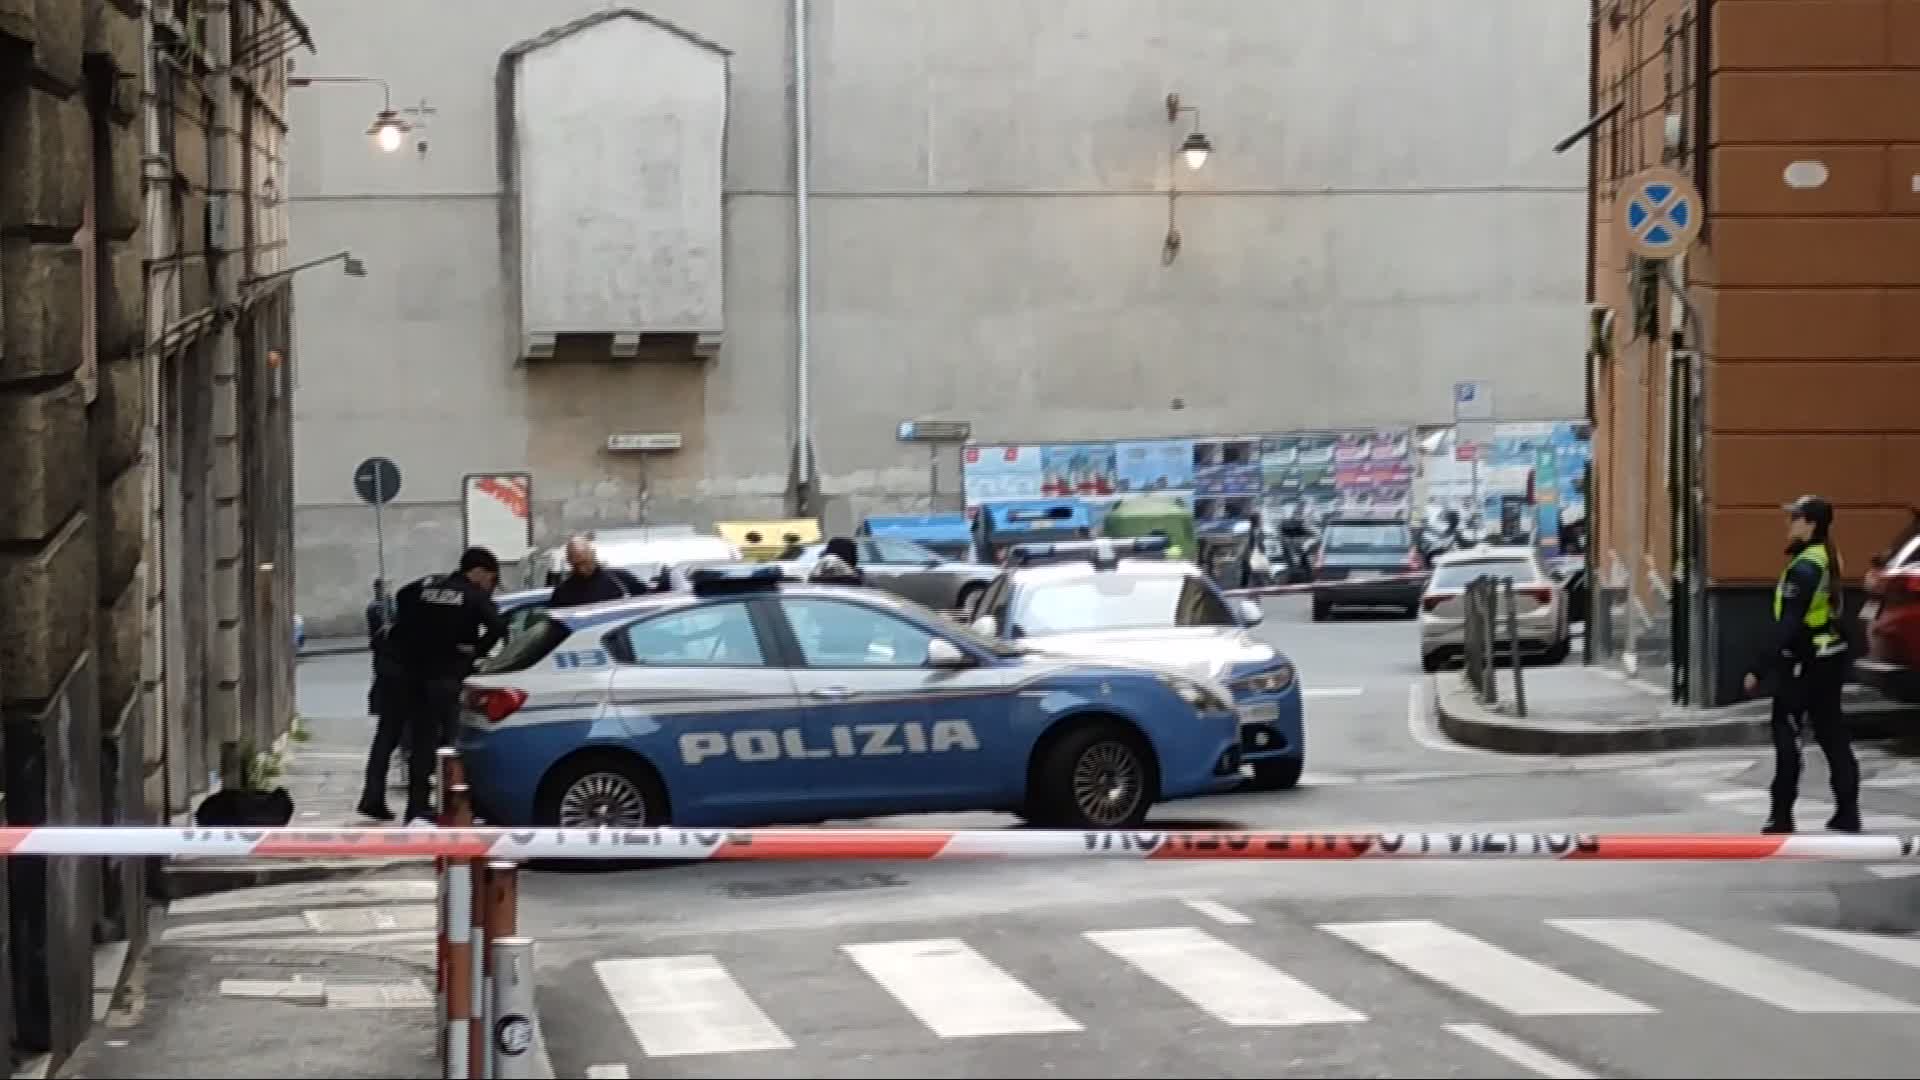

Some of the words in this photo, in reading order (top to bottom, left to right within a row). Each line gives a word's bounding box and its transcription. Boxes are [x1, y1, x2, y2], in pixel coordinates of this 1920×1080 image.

[420, 588, 464, 605] POLIZIA
[554, 650, 607, 667] 113
[679, 719, 980, 765] POLIZIA
